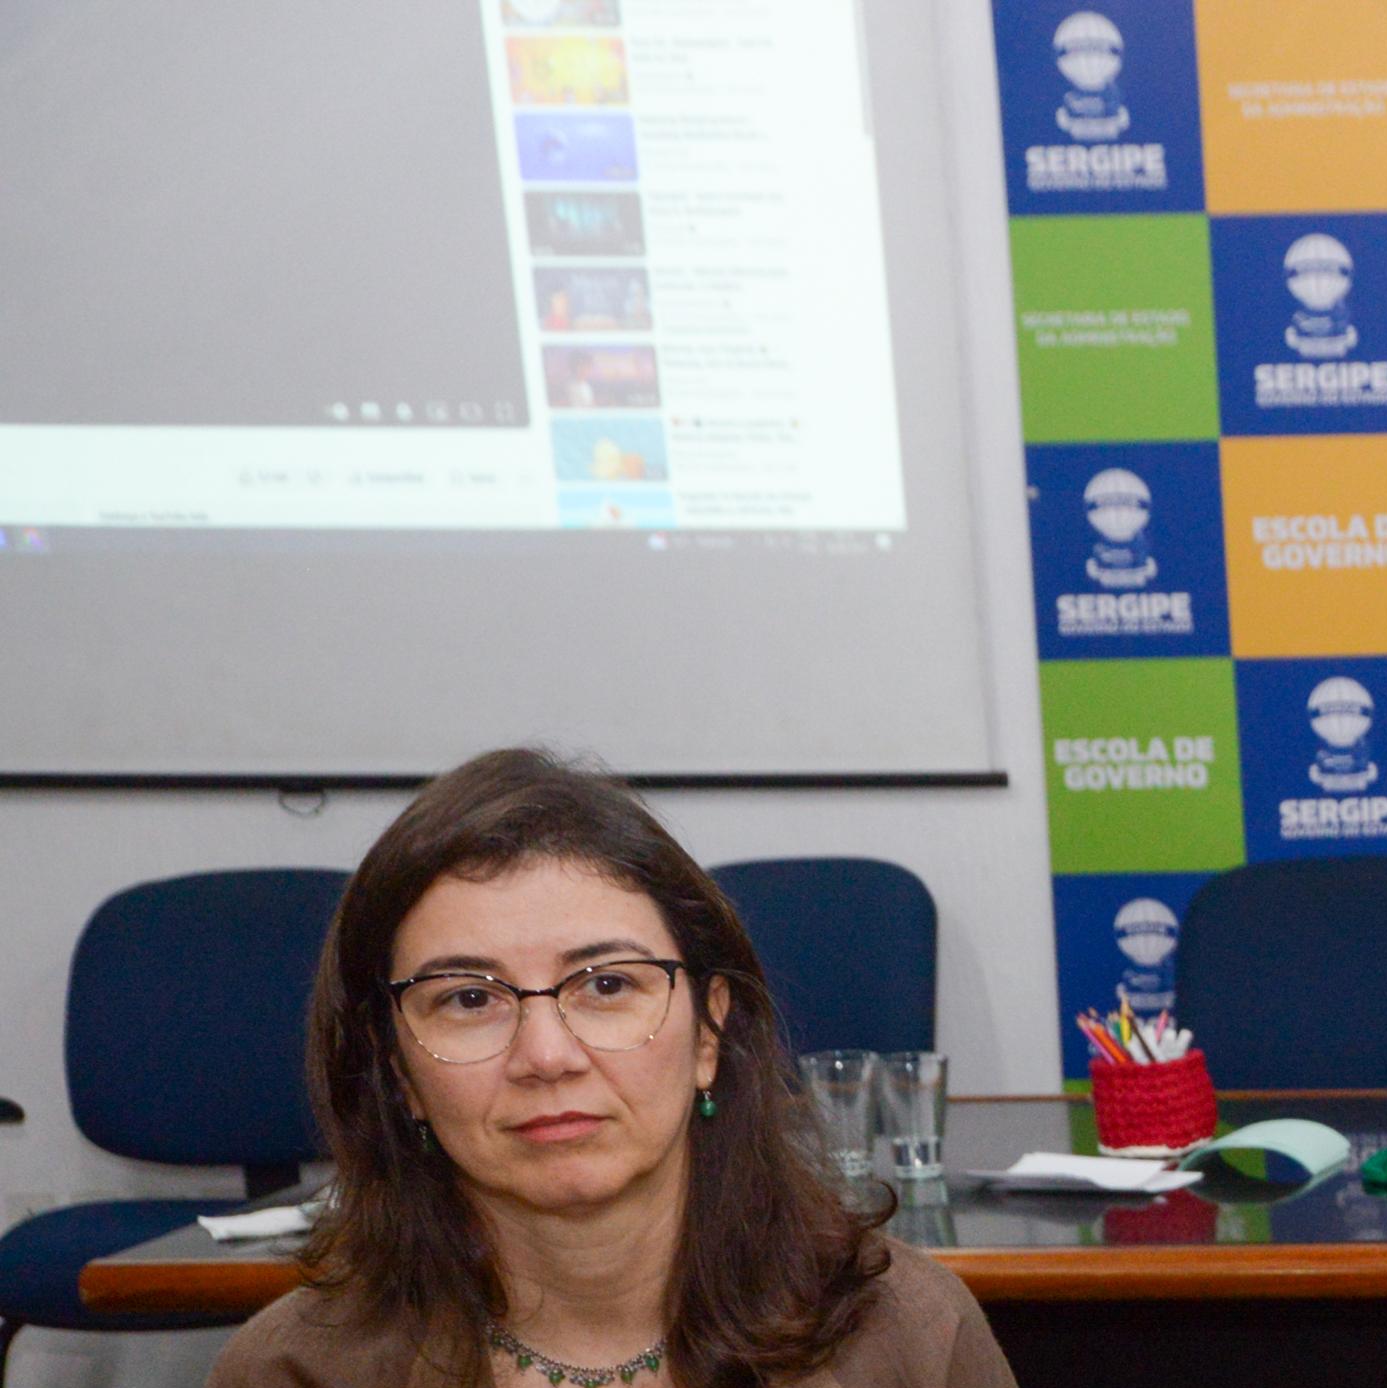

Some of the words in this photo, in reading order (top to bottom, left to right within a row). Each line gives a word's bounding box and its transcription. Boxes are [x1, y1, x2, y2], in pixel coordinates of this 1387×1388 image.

[1027, 146, 1166, 176] SERGIPE
[1253, 514, 1371, 543] ESCOLA
[1058, 594, 1193, 622] SERGIPE
[1055, 737, 1170, 765] ESCOLA
[1174, 737, 1215, 762] DE
[1063, 763, 1209, 791] GOVERNO
